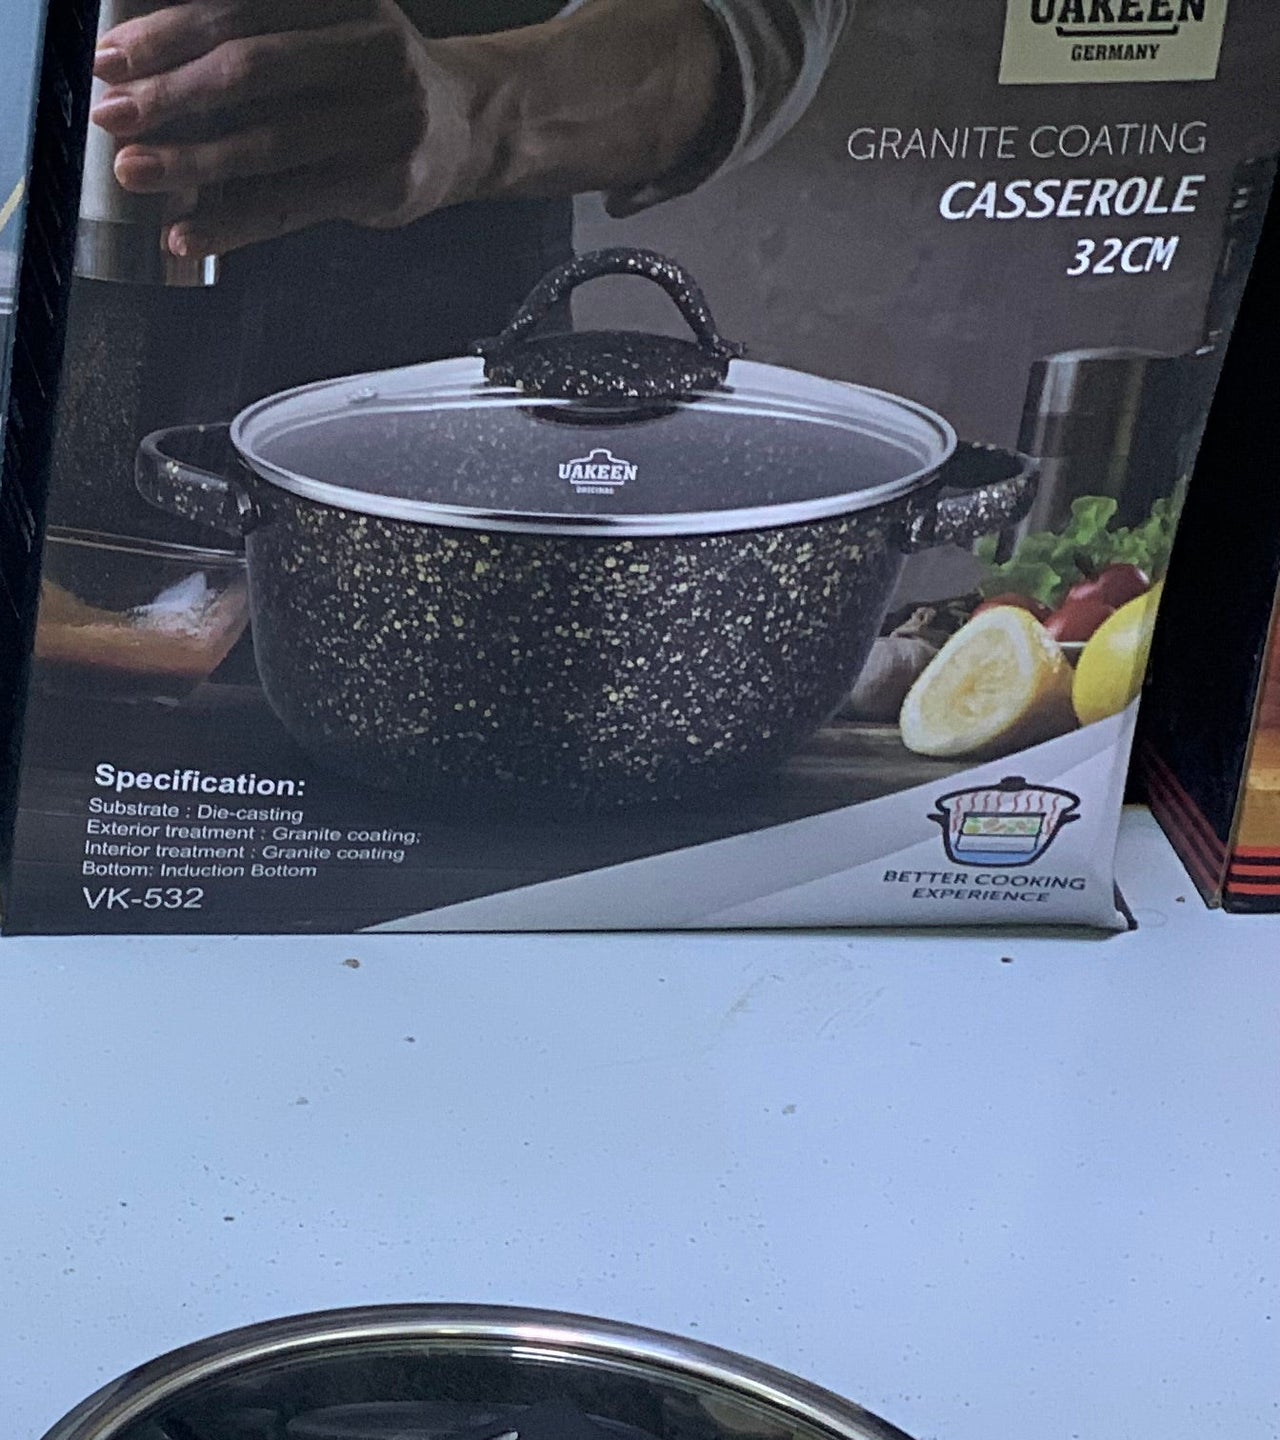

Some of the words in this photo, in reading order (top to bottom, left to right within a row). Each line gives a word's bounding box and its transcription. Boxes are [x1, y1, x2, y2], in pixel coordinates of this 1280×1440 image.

[1030, 0, 1205, 25] UAKEEN
[1071, 44, 1160, 62] GERMANY
[847, 126, 1019, 160] GRANITE
[1030, 121, 1207, 159] COATING
[940, 174, 1206, 220] CASSEROLE
[1067, 236, 1179, 276] 32CM
[559, 463, 638, 480] UAKEEN
[95, 763, 305, 797] Specification:
[89, 798, 180, 818] Substrate
[197, 804, 303, 824] Die-casting
[86, 820, 161, 837] Exterior
[166, 824, 255, 840] treatment
[272, 827, 341, 842] Granite
[84, 840, 151, 857] Interior
[155, 843, 245, 859] treatment
[262, 845, 331, 860] Granite
[336, 848, 405, 862] coating
[82, 861, 154, 877] Bottom:
[160, 863, 244, 878] Induction
[251, 864, 317, 878] Bottom
[883, 870, 968, 885] BETTER
[974, 873, 1087, 890] COOKING
[82, 887, 204, 910] VK-532
[912, 888, 1050, 902] EXPERIENCE
